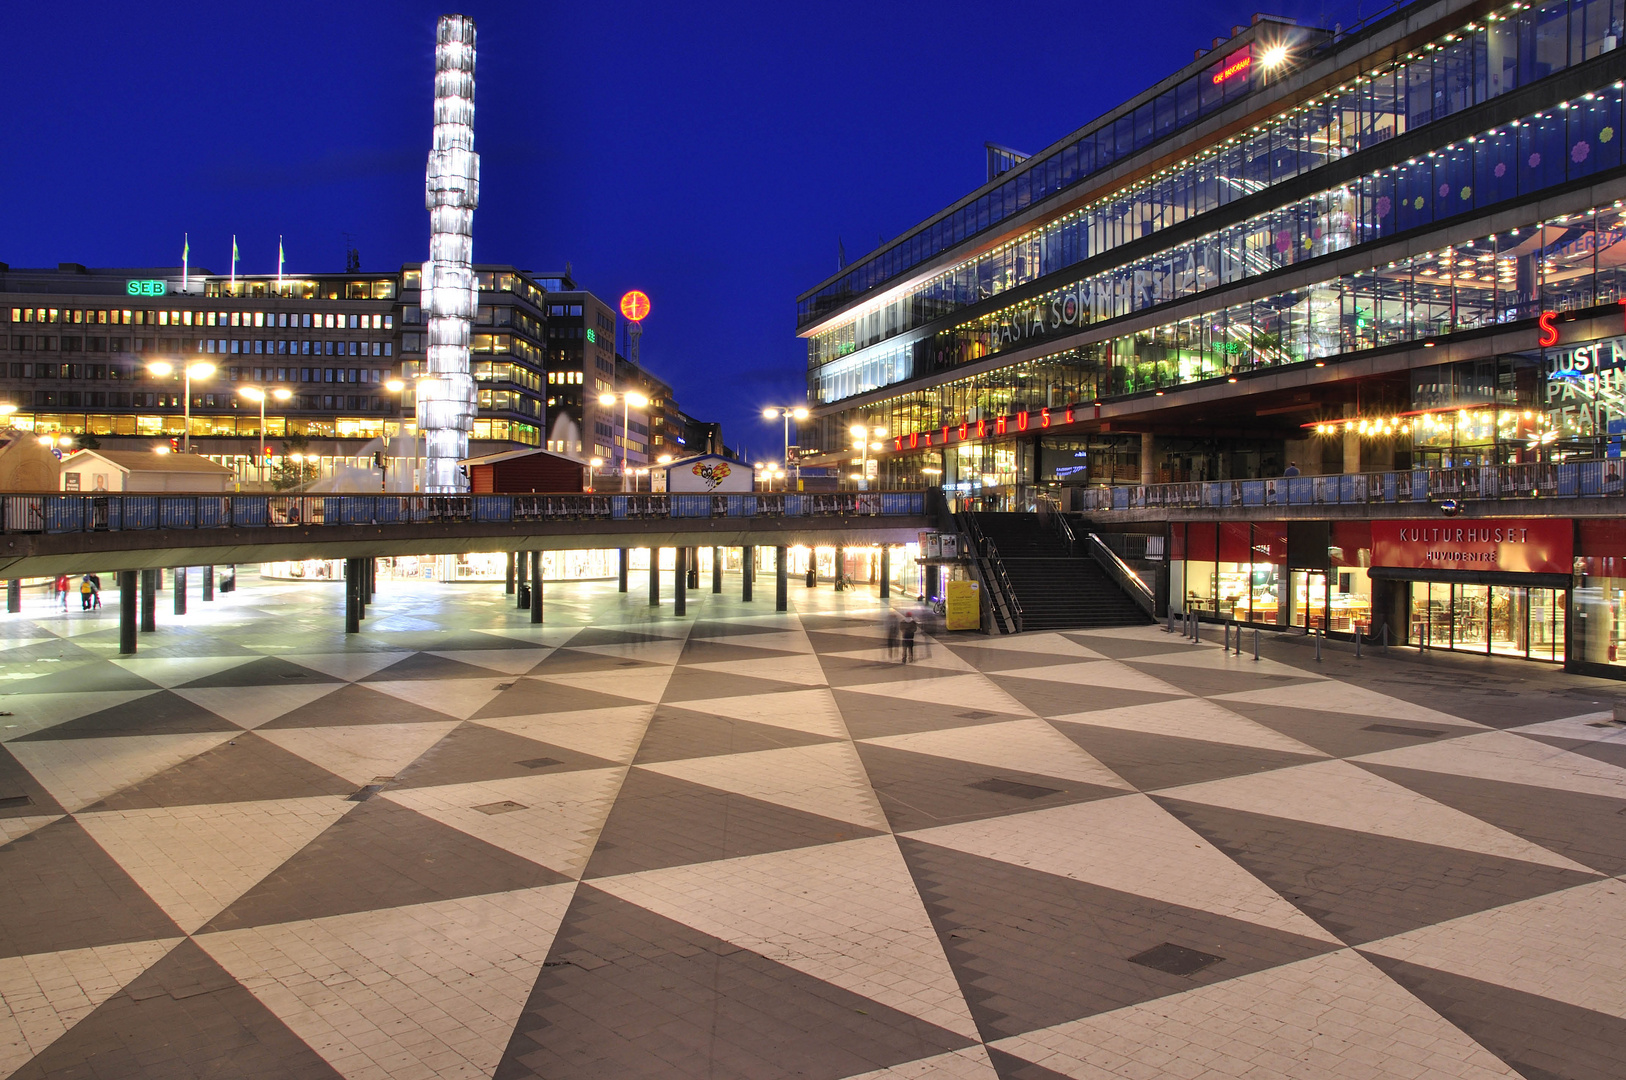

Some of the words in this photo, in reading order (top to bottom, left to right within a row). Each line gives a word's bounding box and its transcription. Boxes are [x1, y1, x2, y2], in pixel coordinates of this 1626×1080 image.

[128, 280, 165, 296] SEB
[1545, 342, 1602, 377] JUST
[1399, 528, 1527, 544] KULTURHUSET
[1426, 550, 1497, 563] HUVUDENTRÉ
